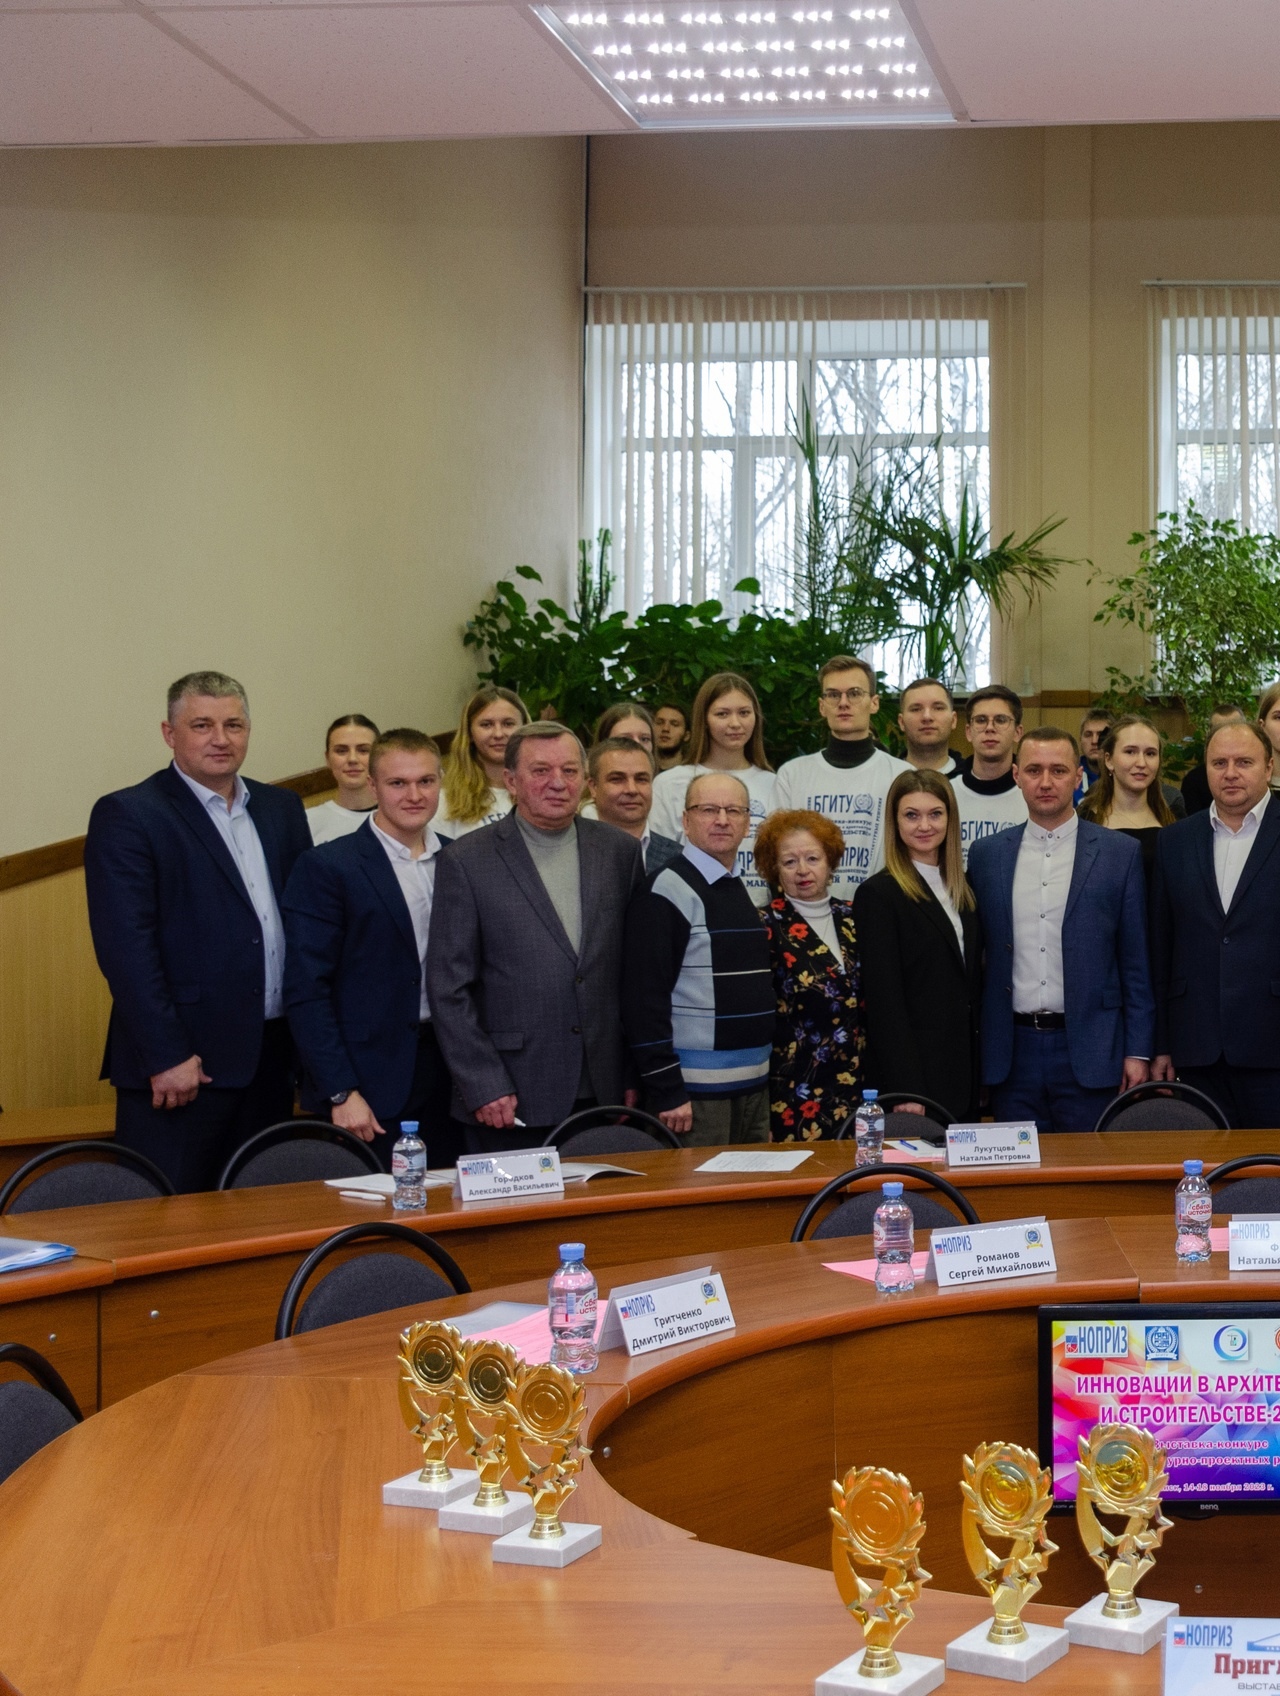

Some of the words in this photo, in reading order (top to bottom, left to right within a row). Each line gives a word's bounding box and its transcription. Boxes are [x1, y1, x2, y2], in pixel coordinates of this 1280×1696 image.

[814, 794, 853, 814] БГИТУ
[960, 820, 999, 841] БГИТУ
[841, 846, 870, 868] ПРИЗ
[954, 1131, 977, 1143] НОПРИЗ
[960, 1154, 993, 1163] Наталья
[994, 1153, 1031, 1162] Петровна
[974, 1145, 1016, 1154] Лукутцова
[467, 1161, 494, 1176] НОПРИЗ
[469, 1185, 512, 1197] Александр
[513, 1180, 560, 1194] Васильевич
[1239, 1223, 1270, 1240] НОПРИЗ
[942, 1234, 973, 1254] НОПРИЗ
[976, 1250, 1020, 1264] Романов
[949, 1267, 984, 1280] Сергей
[986, 1258, 1051, 1276] Михайлович
[626, 1294, 656, 1319] НОПРИЗ
[654, 1307, 703, 1328] Гритченко
[632, 1328, 677, 1351] Дмитрий
[678, 1314, 731, 1336] Викторович
[1078, 1325, 1127, 1354] НОПРИЗ
[1077, 1375, 1192, 1396] ИННОВАЦИИ
[1198, 1375, 1209, 1393] В
[1101, 1406, 1113, 1424] И
[1167, 1455, 1270, 1467] урно-проектных
[1183, 1483, 1208, 1492] 14-18
[1209, 1483, 1242, 1493] ноября
[1243, 1483, 1266, 1491] 2023
[1186, 1624, 1233, 1647] НОПРИЗ
